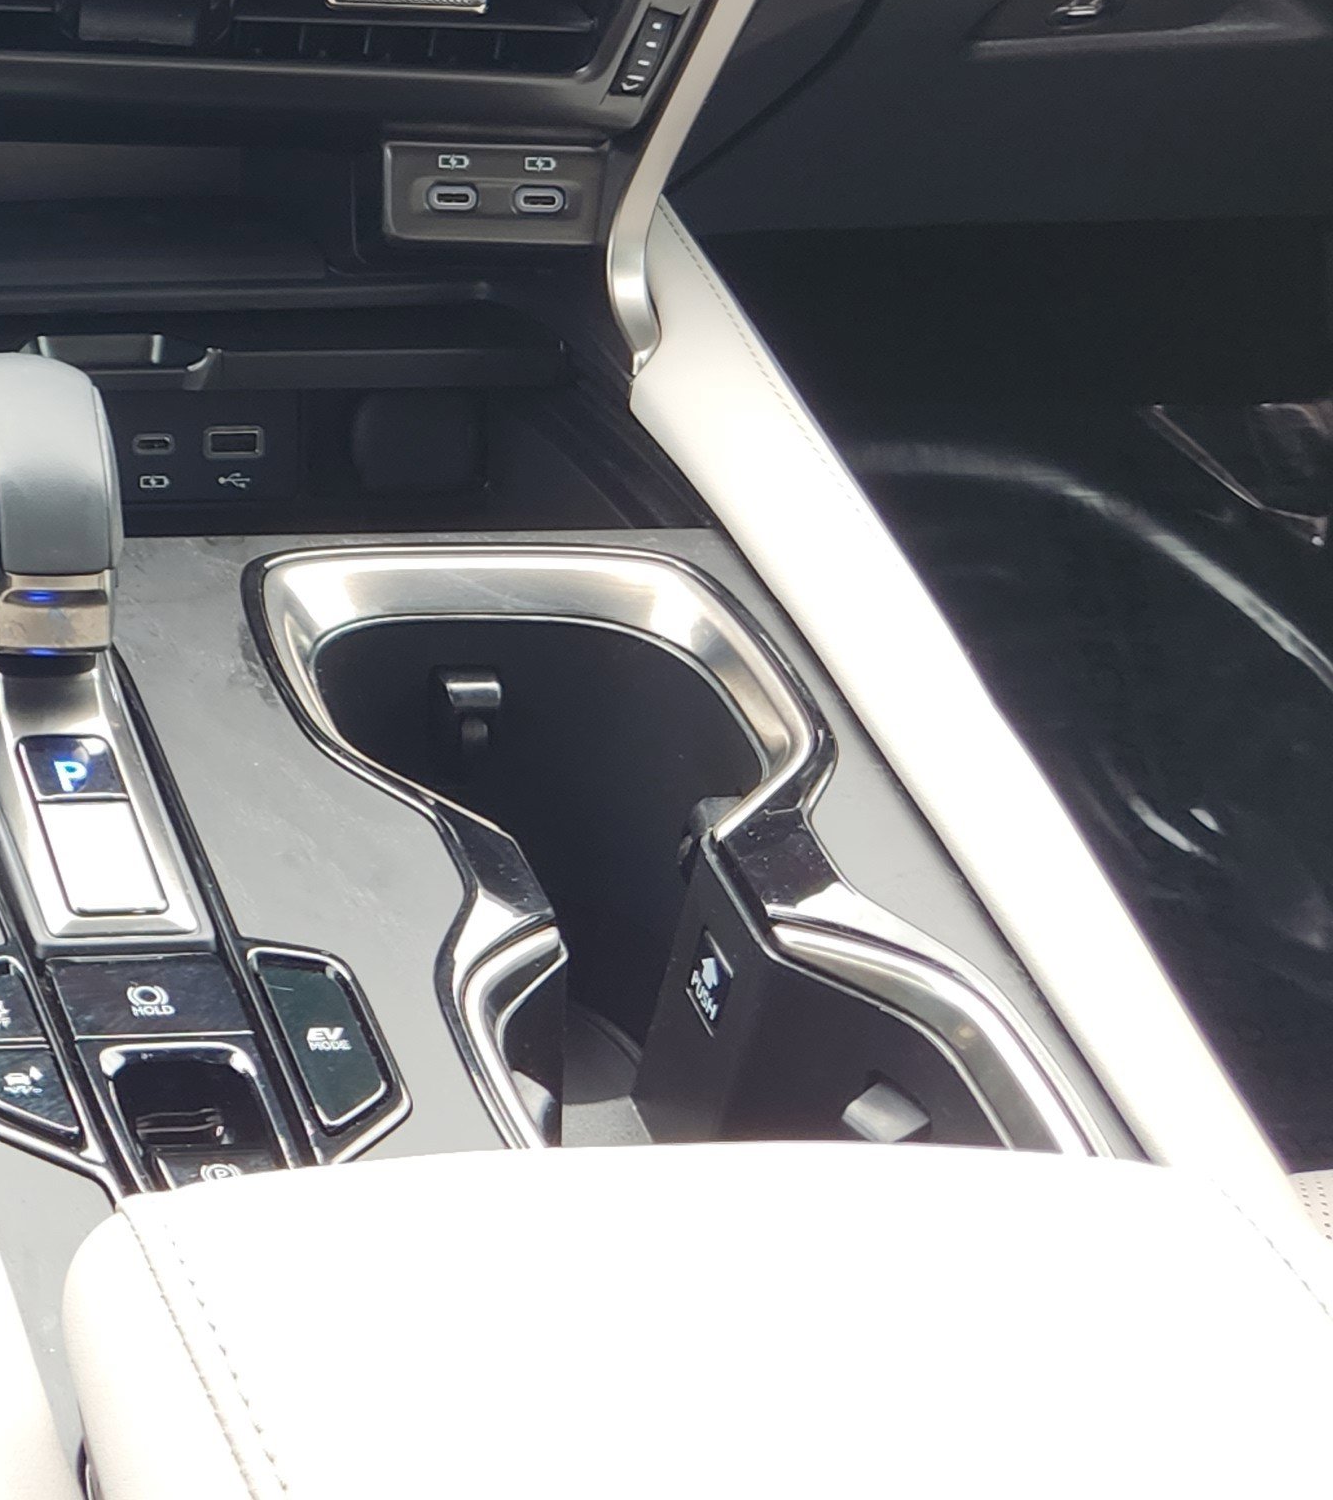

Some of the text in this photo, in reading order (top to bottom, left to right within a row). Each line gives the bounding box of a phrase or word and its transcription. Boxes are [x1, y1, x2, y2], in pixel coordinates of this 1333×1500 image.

[54, 759, 88, 792] P
[132, 1004, 176, 1017] HOLD
[306, 1026, 345, 1041] EV
[308, 1040, 352, 1052] MODE
